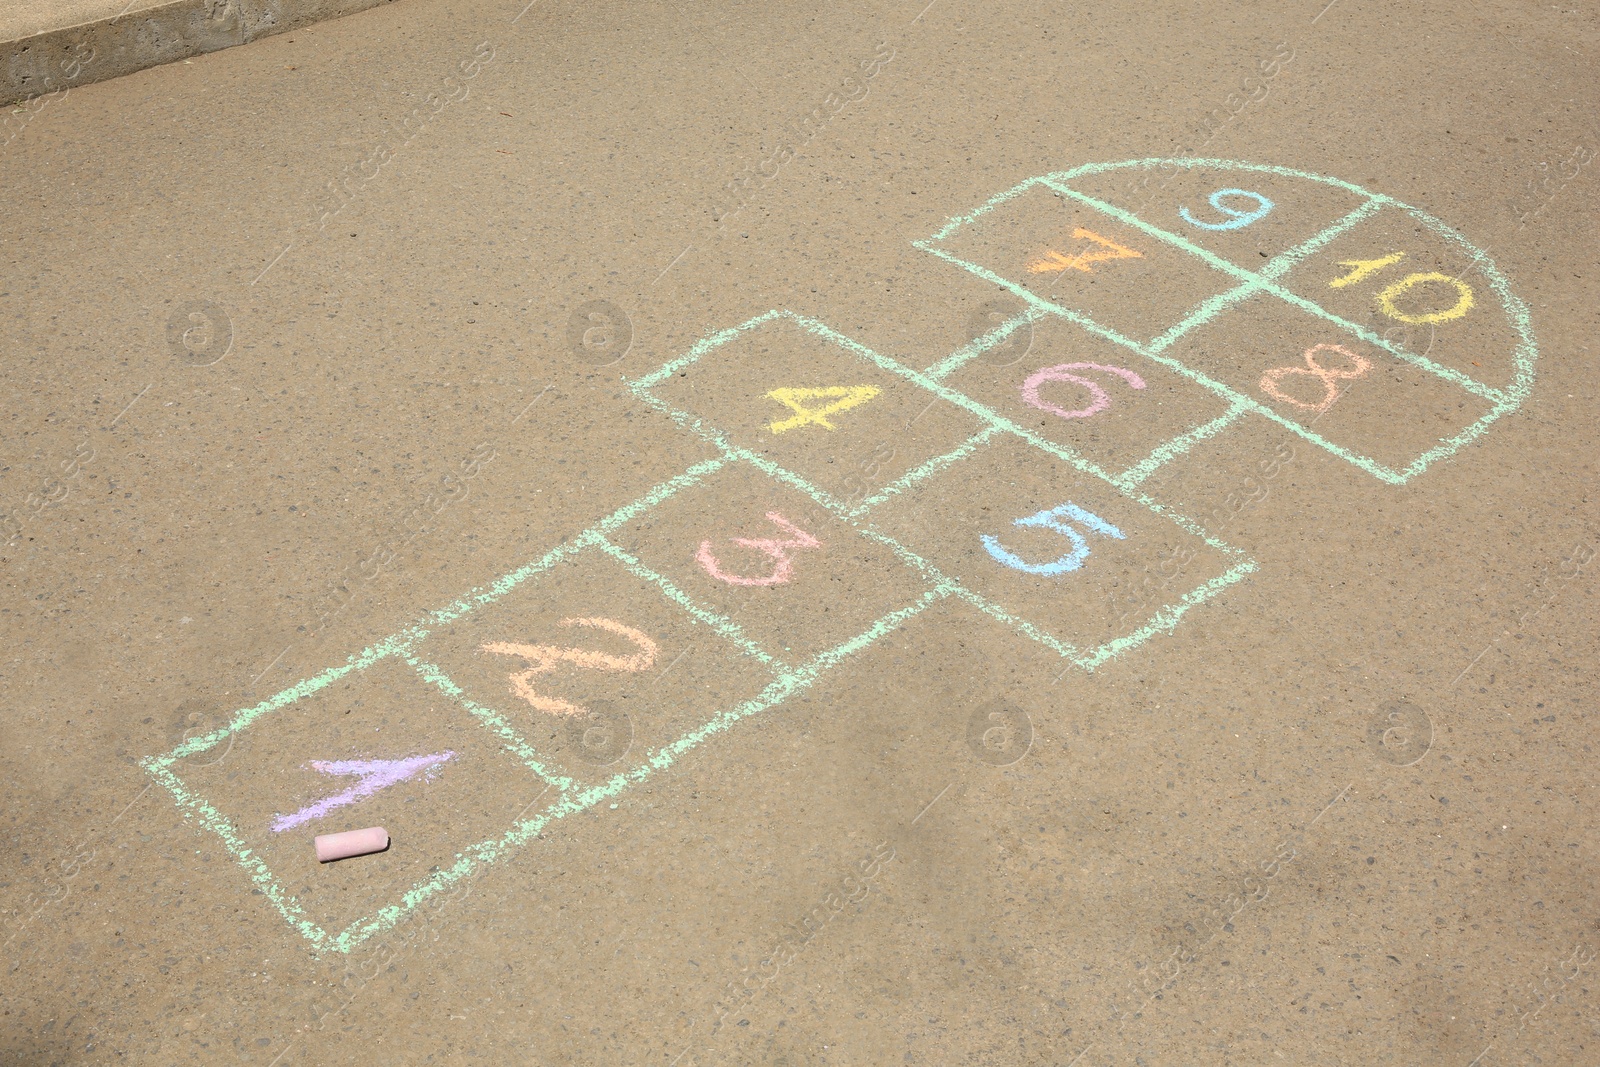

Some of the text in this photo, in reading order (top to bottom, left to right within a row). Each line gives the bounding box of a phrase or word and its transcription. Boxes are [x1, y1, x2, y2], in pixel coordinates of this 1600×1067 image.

[1178, 187, 1275, 232] 9
[1027, 227, 1144, 274] 7
[1328, 251, 1477, 325] 10
[763, 384, 882, 435] 4
[1018, 361, 1147, 419] 6
[1259, 342, 1373, 414] 8
[695, 511, 823, 588] 3
[978, 500, 1127, 579] 5
[480, 615, 662, 717] 2
[269, 749, 458, 834] 1
